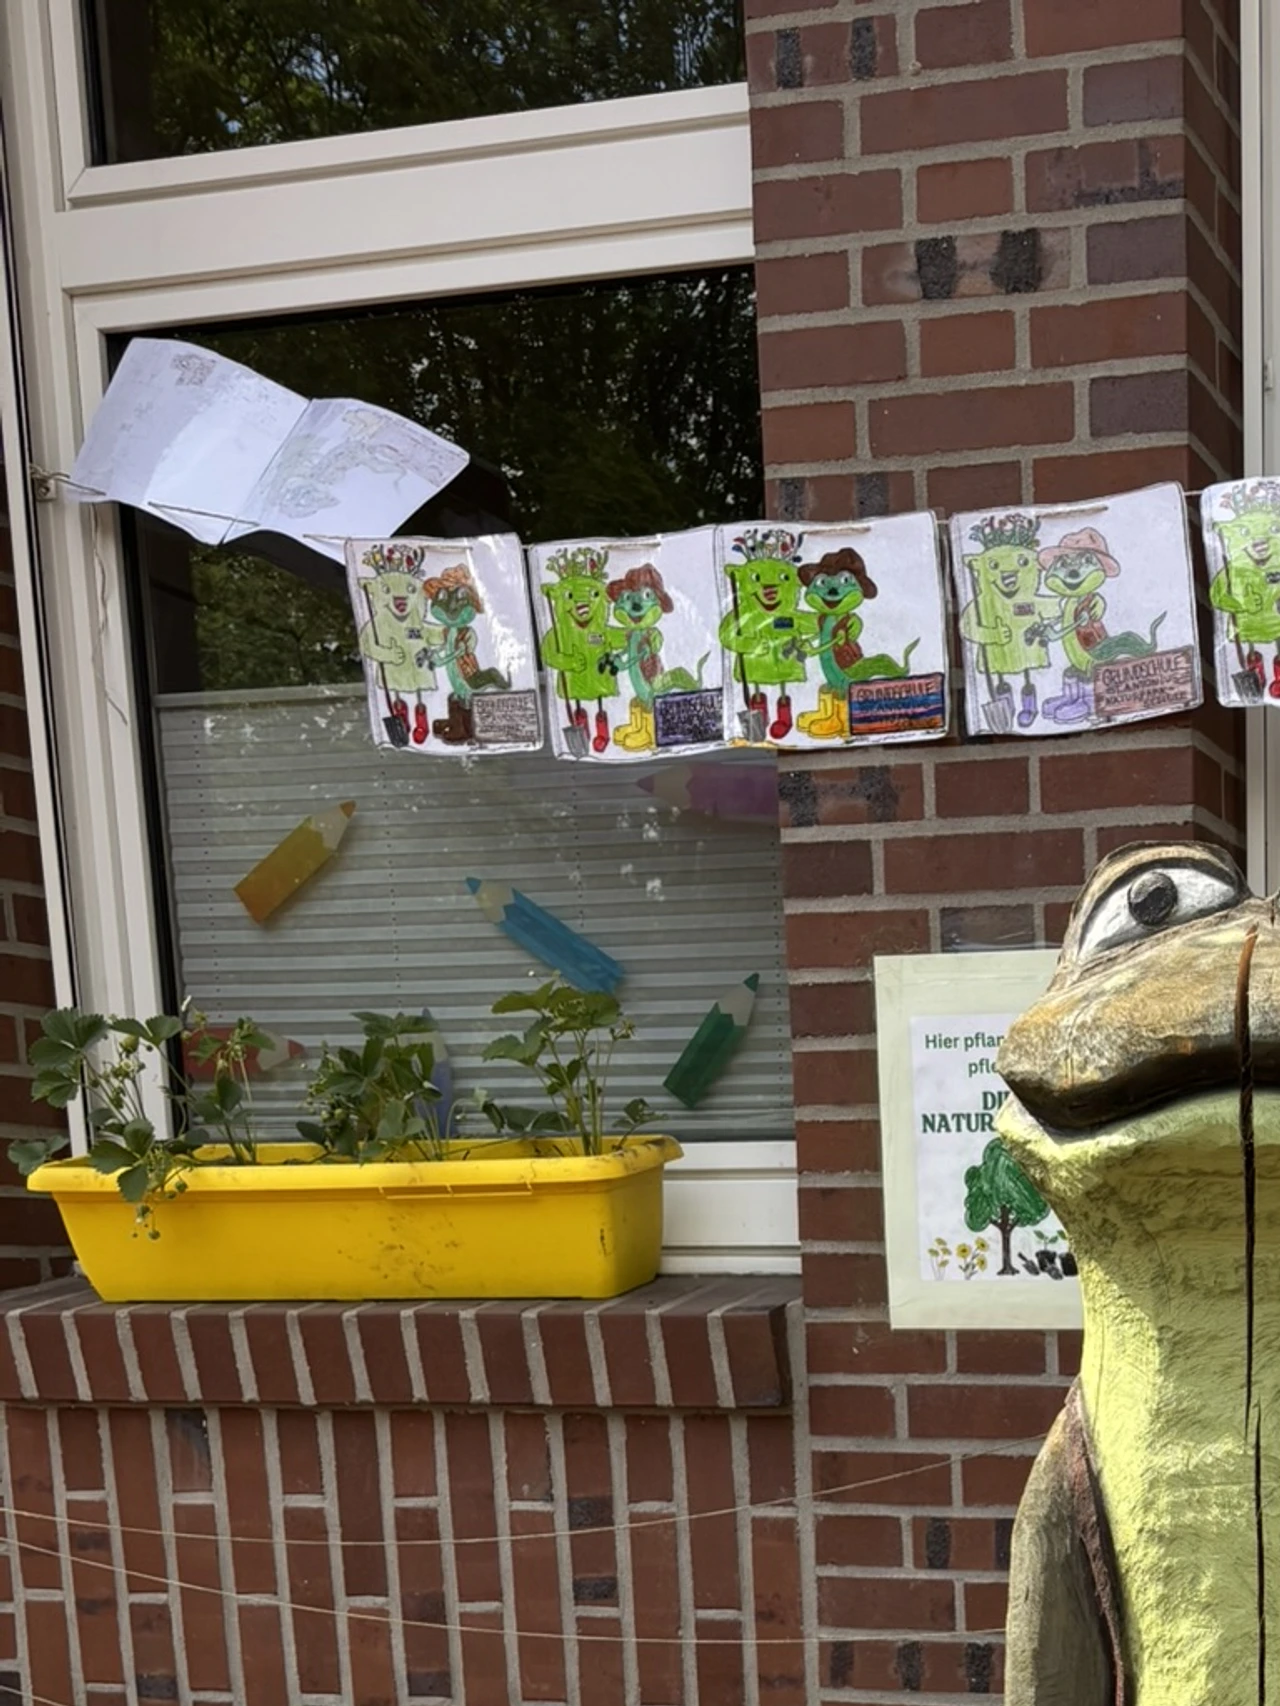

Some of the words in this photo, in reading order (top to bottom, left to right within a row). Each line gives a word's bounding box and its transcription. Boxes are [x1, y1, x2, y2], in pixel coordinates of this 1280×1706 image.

[1102, 656, 1190, 687] GRUNDSCHULE
[925, 1033, 960, 1049] Hier
[922, 1112, 996, 1133] NATUR
